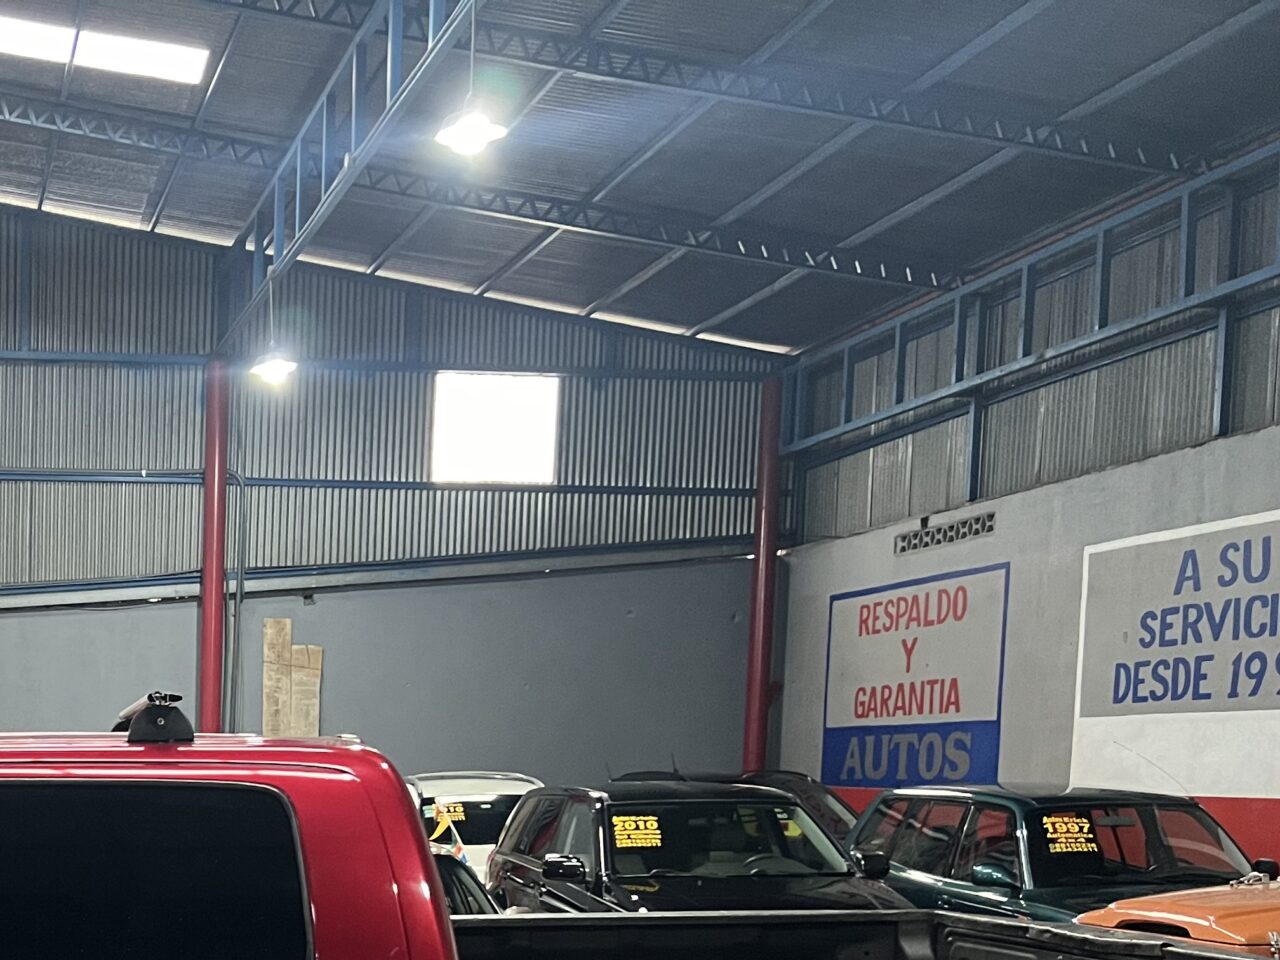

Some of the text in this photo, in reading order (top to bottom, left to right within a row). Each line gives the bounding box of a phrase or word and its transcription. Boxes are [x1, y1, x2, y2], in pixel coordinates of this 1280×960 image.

[1173, 535, 1271, 596] A SU
[858, 585, 968, 637] RESPALDO
[901, 637, 918, 673] Y
[1112, 650, 1280, 704] DESDE 19
[854, 677, 961, 719] GARANTIA
[840, 730, 972, 781] AUTOS
[613, 820, 658, 830] 2010
[1043, 822, 1090, 832] 1997
